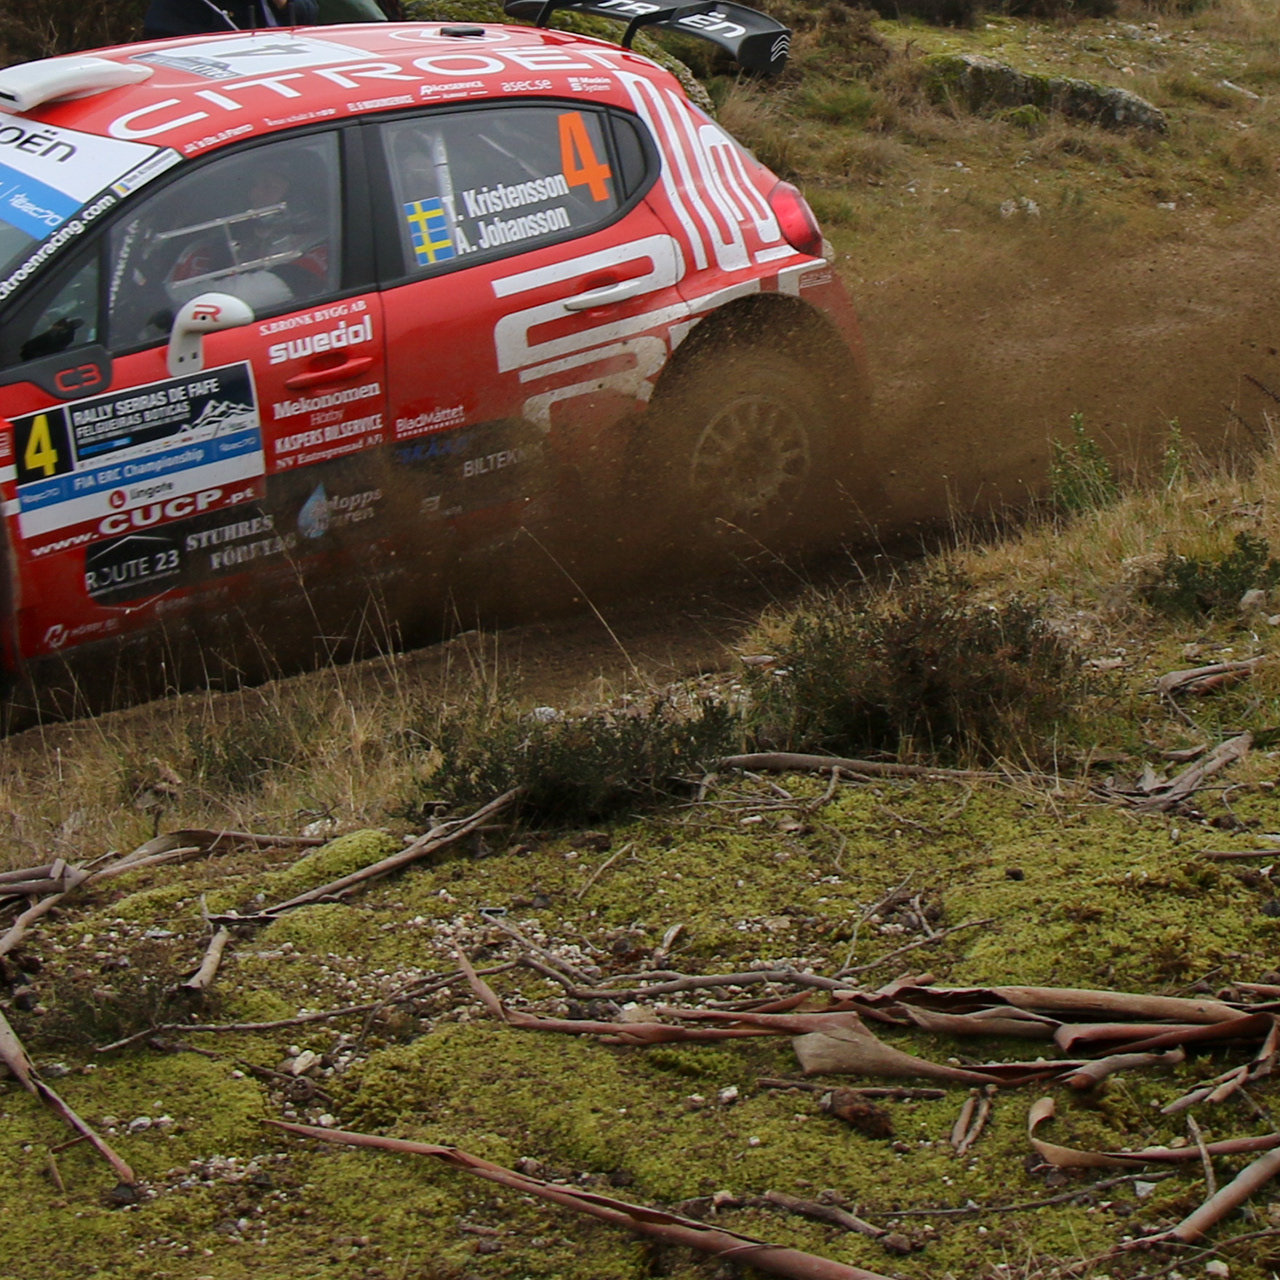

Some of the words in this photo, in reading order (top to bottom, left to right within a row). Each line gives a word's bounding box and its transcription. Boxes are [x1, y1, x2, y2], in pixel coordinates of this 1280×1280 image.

[501, 79, 552, 92] asec.se
[556, 111, 613, 202] 4
[441, 195, 464, 222] T.
[463, 173, 570, 218] Kristensson
[454, 226, 478, 255] A.
[478, 206, 571, 250] Johansson
[314, 304, 349, 322] BYGG
[349, 300, 367, 313] AB
[268, 314, 373, 365] swedol
[54, 363, 103, 393] C3
[72, 403, 115, 426] RALLY
[114, 390, 169, 416] SERRAS
[169, 385, 187, 401] DE
[187, 378, 221, 398] FAFE
[76, 412, 143, 439] FELGUEIRAS
[143, 401, 192, 423] BOTICAS
[273, 382, 381, 420] Mekonomen
[24, 413, 59, 478] 4
[274, 427, 323, 455] KASPERS
[323, 413, 384, 442] BILSERVICE
[74, 475, 97, 491] FIA
[97, 468, 122, 485] ERC
[123, 447, 205, 479] Championship
[129, 481, 175, 501] lingote
[31, 488, 255, 557] www.CUCP.pt
[185, 515, 274, 552] STUHRES
[153, 548, 181, 571] 23
